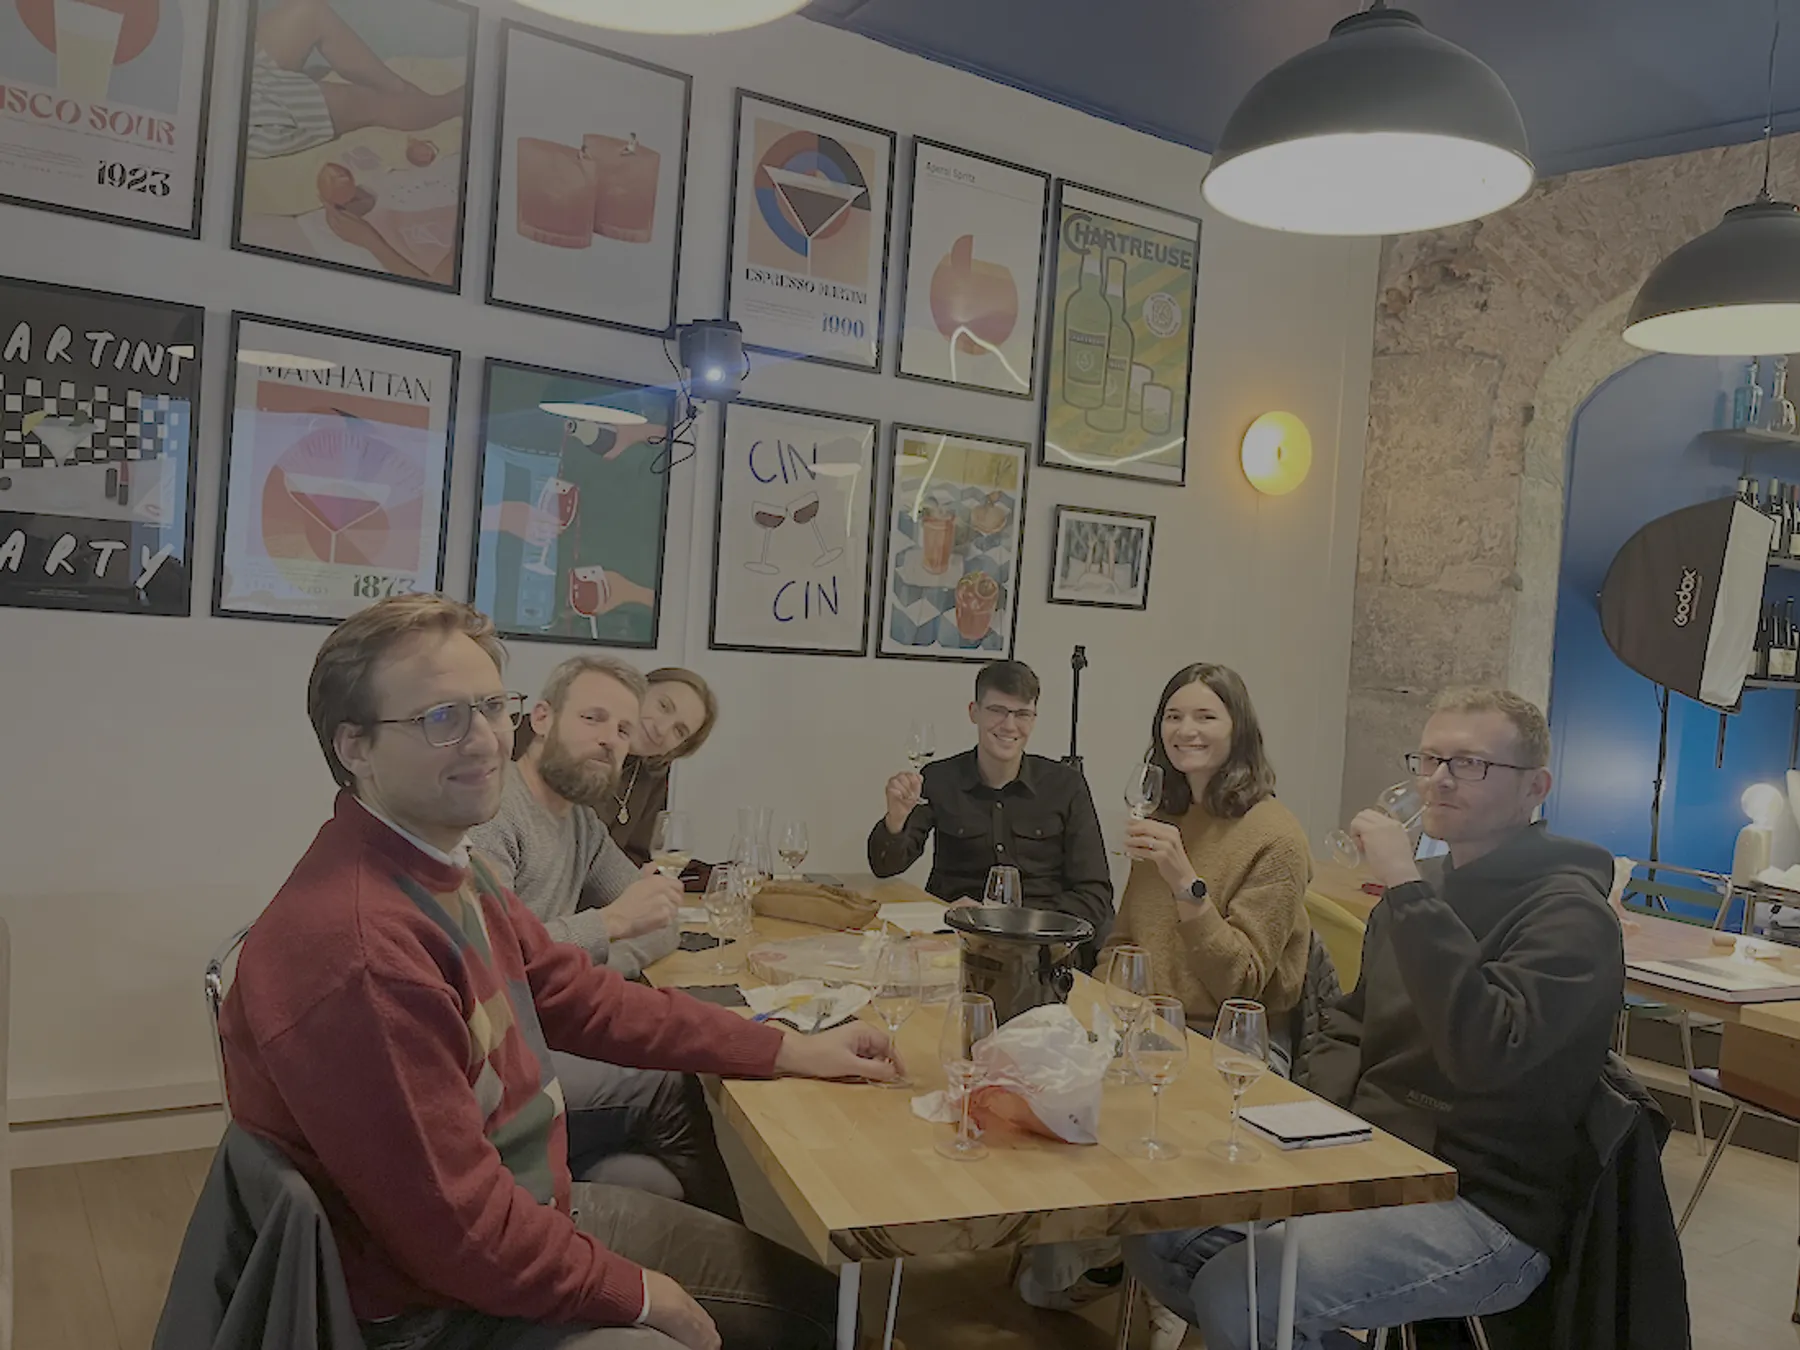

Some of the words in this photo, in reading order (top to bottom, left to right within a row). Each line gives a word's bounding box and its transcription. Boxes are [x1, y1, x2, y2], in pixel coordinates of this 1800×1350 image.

[89, 103, 176, 146] SOUR
[97, 160, 171, 197] 1923
[1063, 212, 1192, 270] CHARTREUSE
[745, 267, 816, 293] ESPRESSO
[749, 440, 817, 484] CIN
[772, 575, 839, 622] CIN
